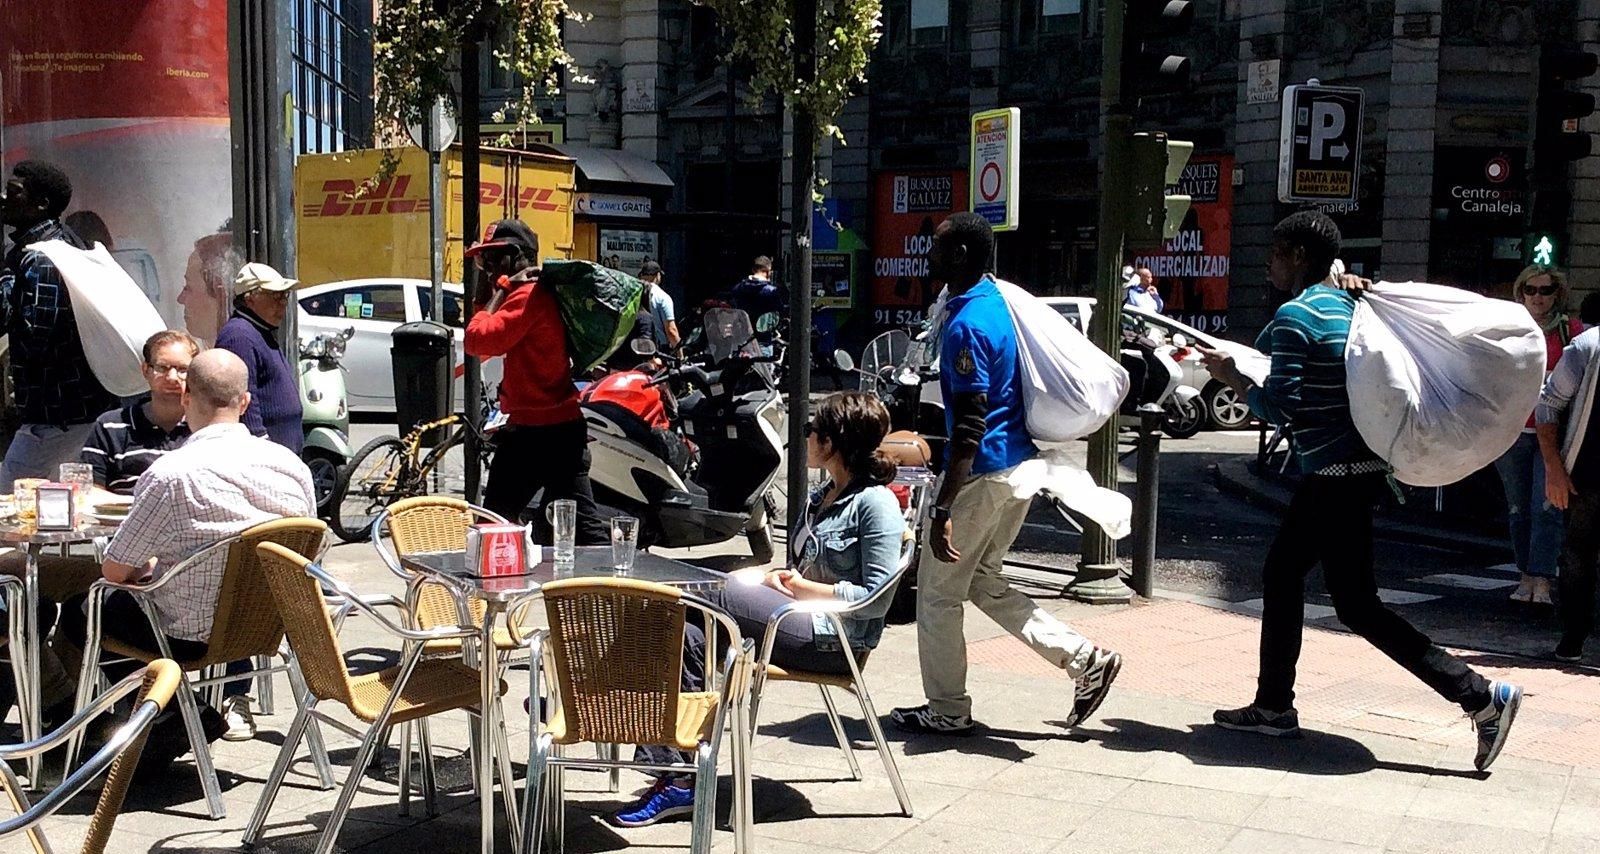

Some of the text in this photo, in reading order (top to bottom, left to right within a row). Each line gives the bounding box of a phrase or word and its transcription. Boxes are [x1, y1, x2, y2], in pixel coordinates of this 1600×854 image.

[56, 52, 93, 61] seguimos
[95, 52, 144, 62] cambiando.
[63, 63, 105, 74] imaginas?
[166, 67, 209, 79] iberia.com
[1310, 101, 1346, 160] P
[1180, 164, 1218, 181] SQUETS
[1298, 171, 1348, 185] SANTA ANA
[910, 177, 951, 191] BUSQUETS
[320, 175, 418, 216] DHL
[480, 182, 558, 211] DHL
[909, 191, 950, 205] GALVEZ
[1451, 185, 1500, 199] Centro
[622, 202, 651, 213] GRATIS
[1461, 199, 1524, 216] Canaleja
[874, 309, 923, 325] 91 524
